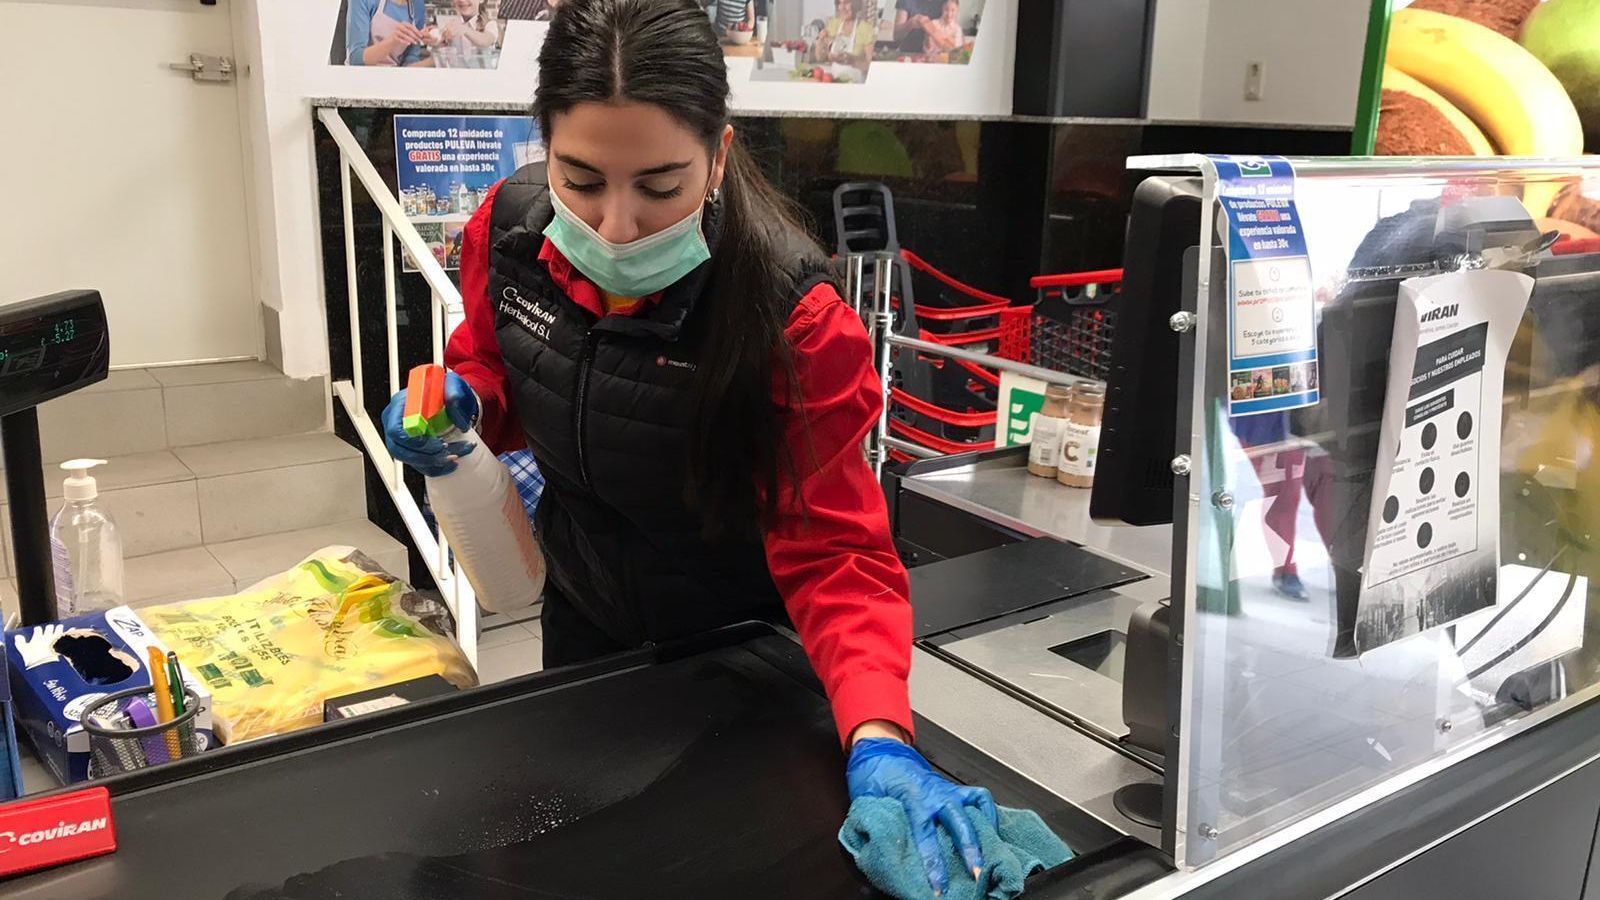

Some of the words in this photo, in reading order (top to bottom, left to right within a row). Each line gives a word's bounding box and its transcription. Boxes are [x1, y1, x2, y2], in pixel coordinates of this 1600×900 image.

[402, 129, 446, 139] Comprando
[447, 128, 458, 138] 12
[459, 129, 492, 138] unidades
[494, 129, 503, 138] de
[405, 141, 444, 150] productos
[445, 140, 476, 149] PULEVA
[477, 140, 502, 149] llévate
[409, 151, 441, 161] GRATIS
[457, 152, 499, 161] experiencia
[415, 164, 448, 173] valorada
[460, 164, 480, 172] hasta
[55, 319, 74, 333] 4.73
[113, 619, 145, 637] ZAP
